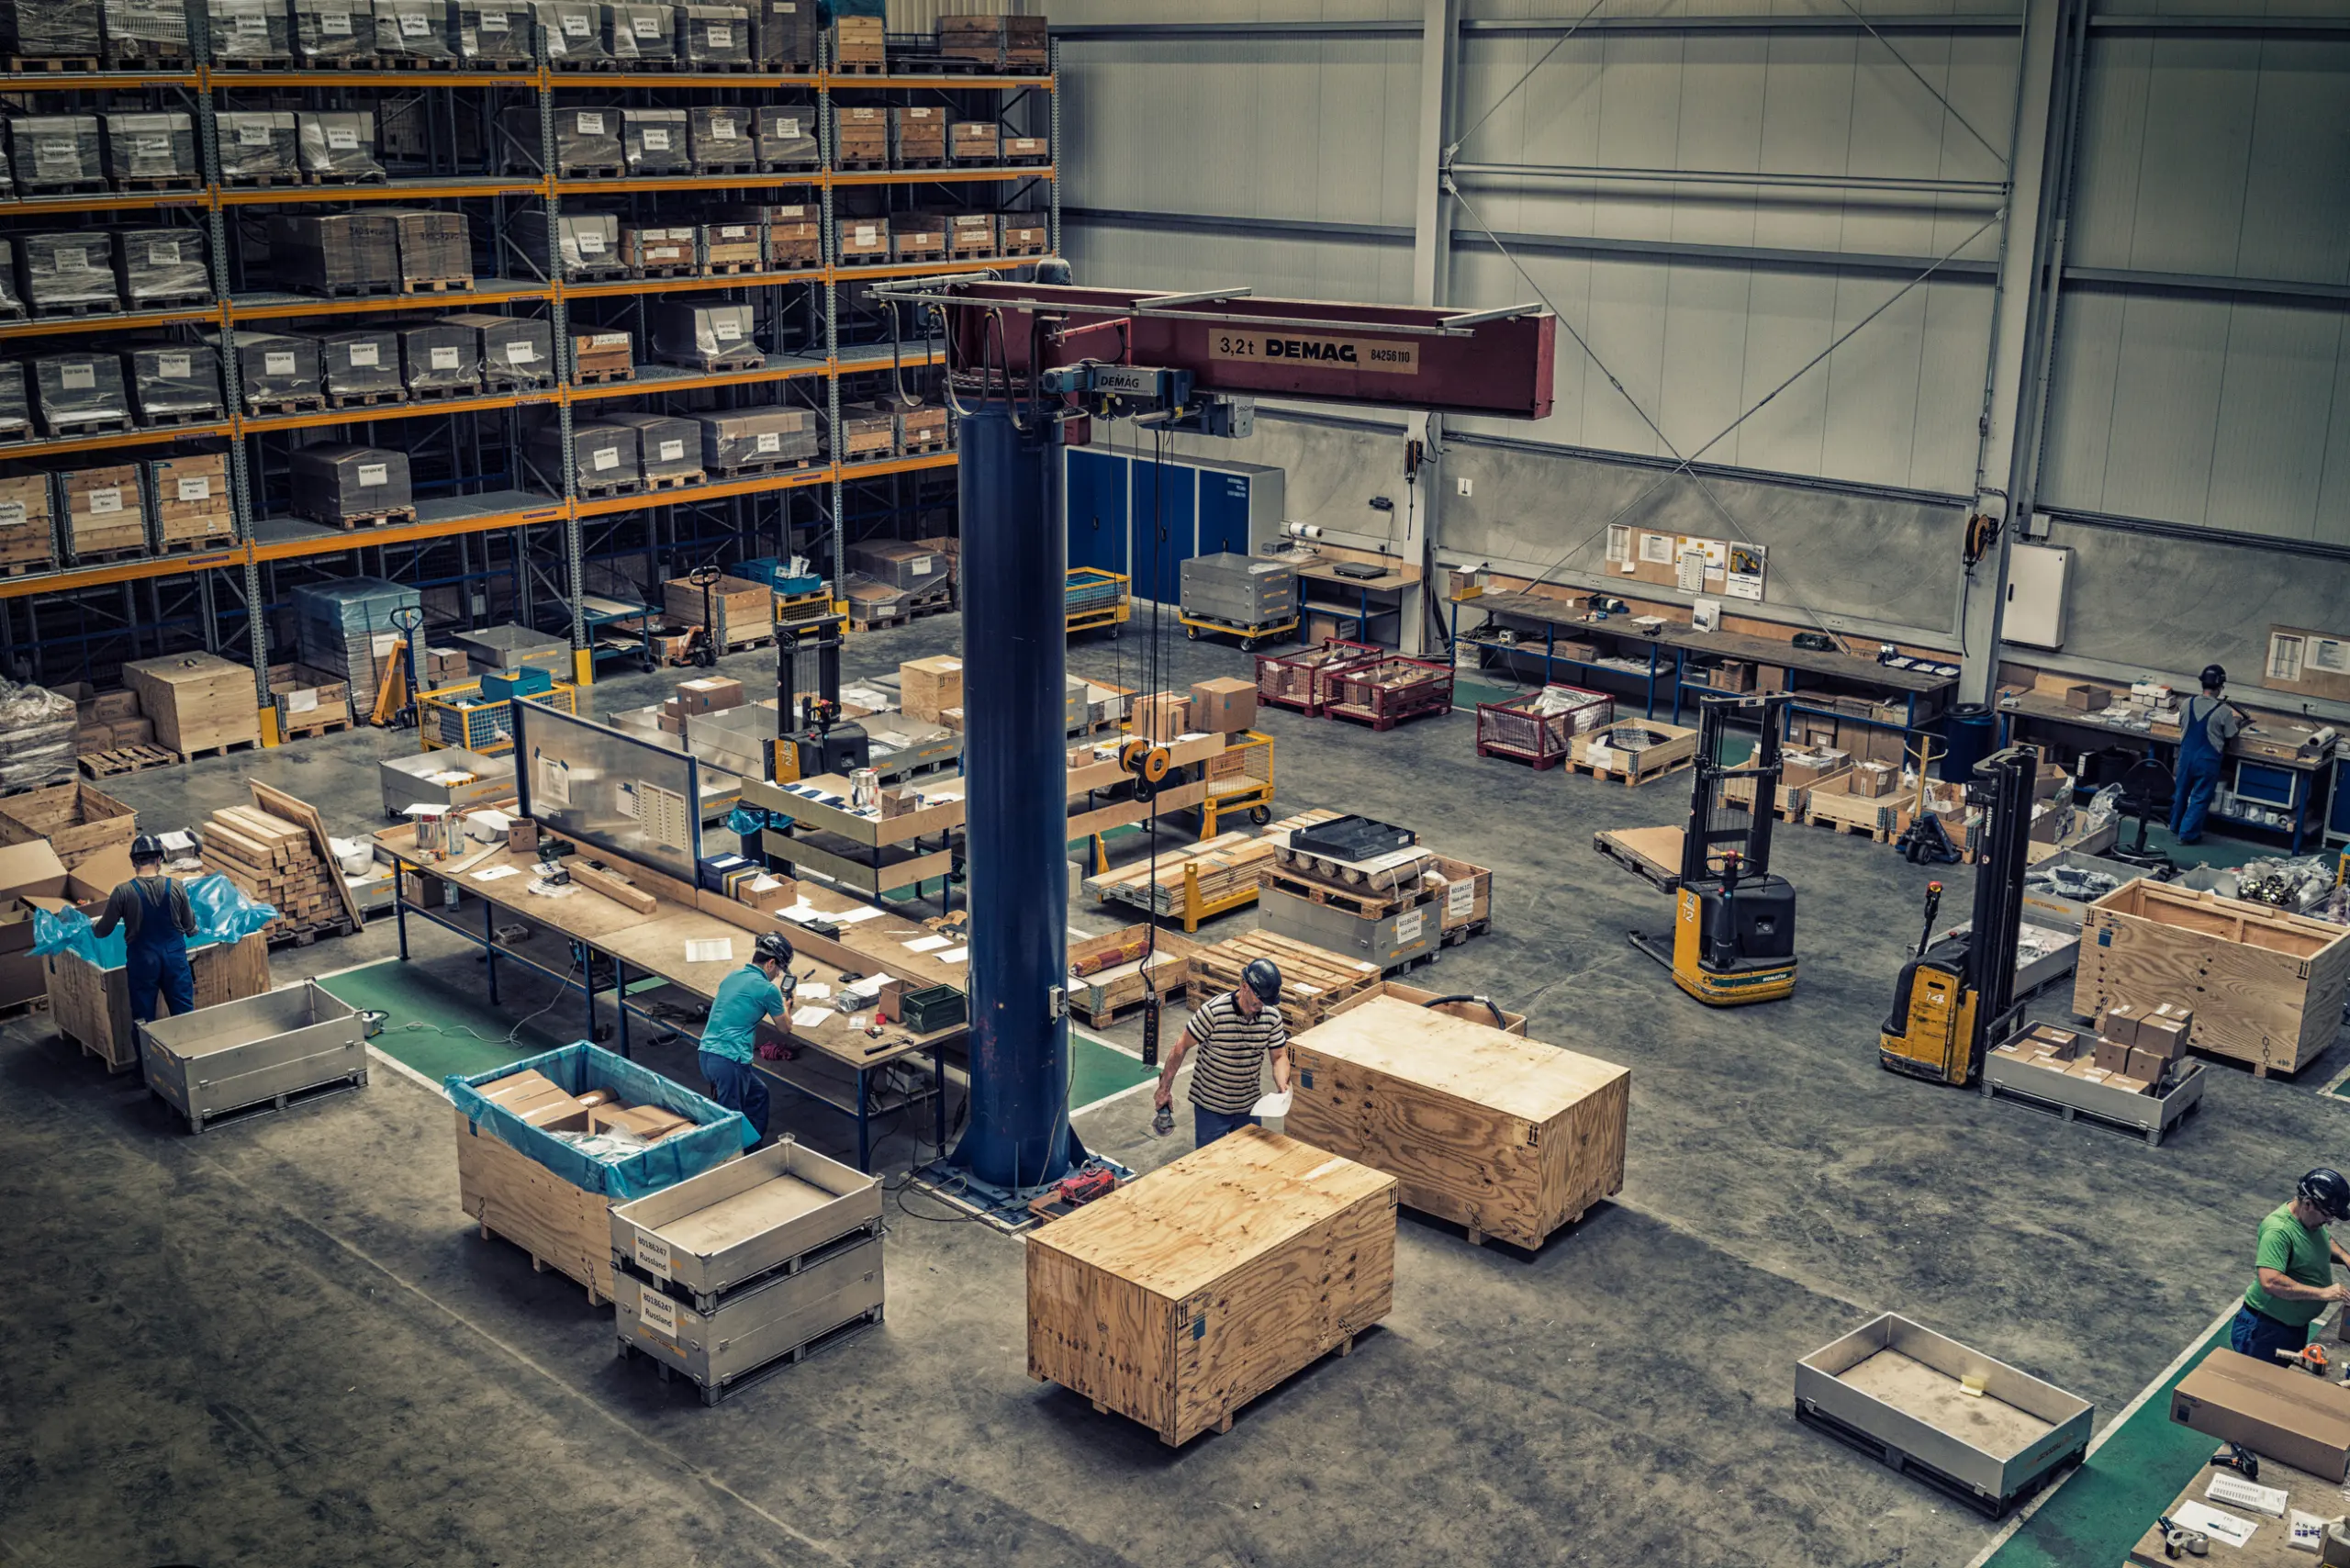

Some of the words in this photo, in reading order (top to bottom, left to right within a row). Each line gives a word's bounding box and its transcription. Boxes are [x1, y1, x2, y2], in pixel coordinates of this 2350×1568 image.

[1220, 337, 1246, 356] 3,2
[1248, 340, 1254, 355] t
[1266, 339, 1357, 363] DEMAG
[1371, 349, 1410, 364] 84256110
[1101, 376, 1139, 388] DEMAG
[1762, 973, 1787, 982] KOMATSU
[637, 1237, 667, 1257] 80186247
[639, 1251, 667, 1271] Russland
[643, 1293, 672, 1312] 80186247
[645, 1307, 672, 1327] Russland
